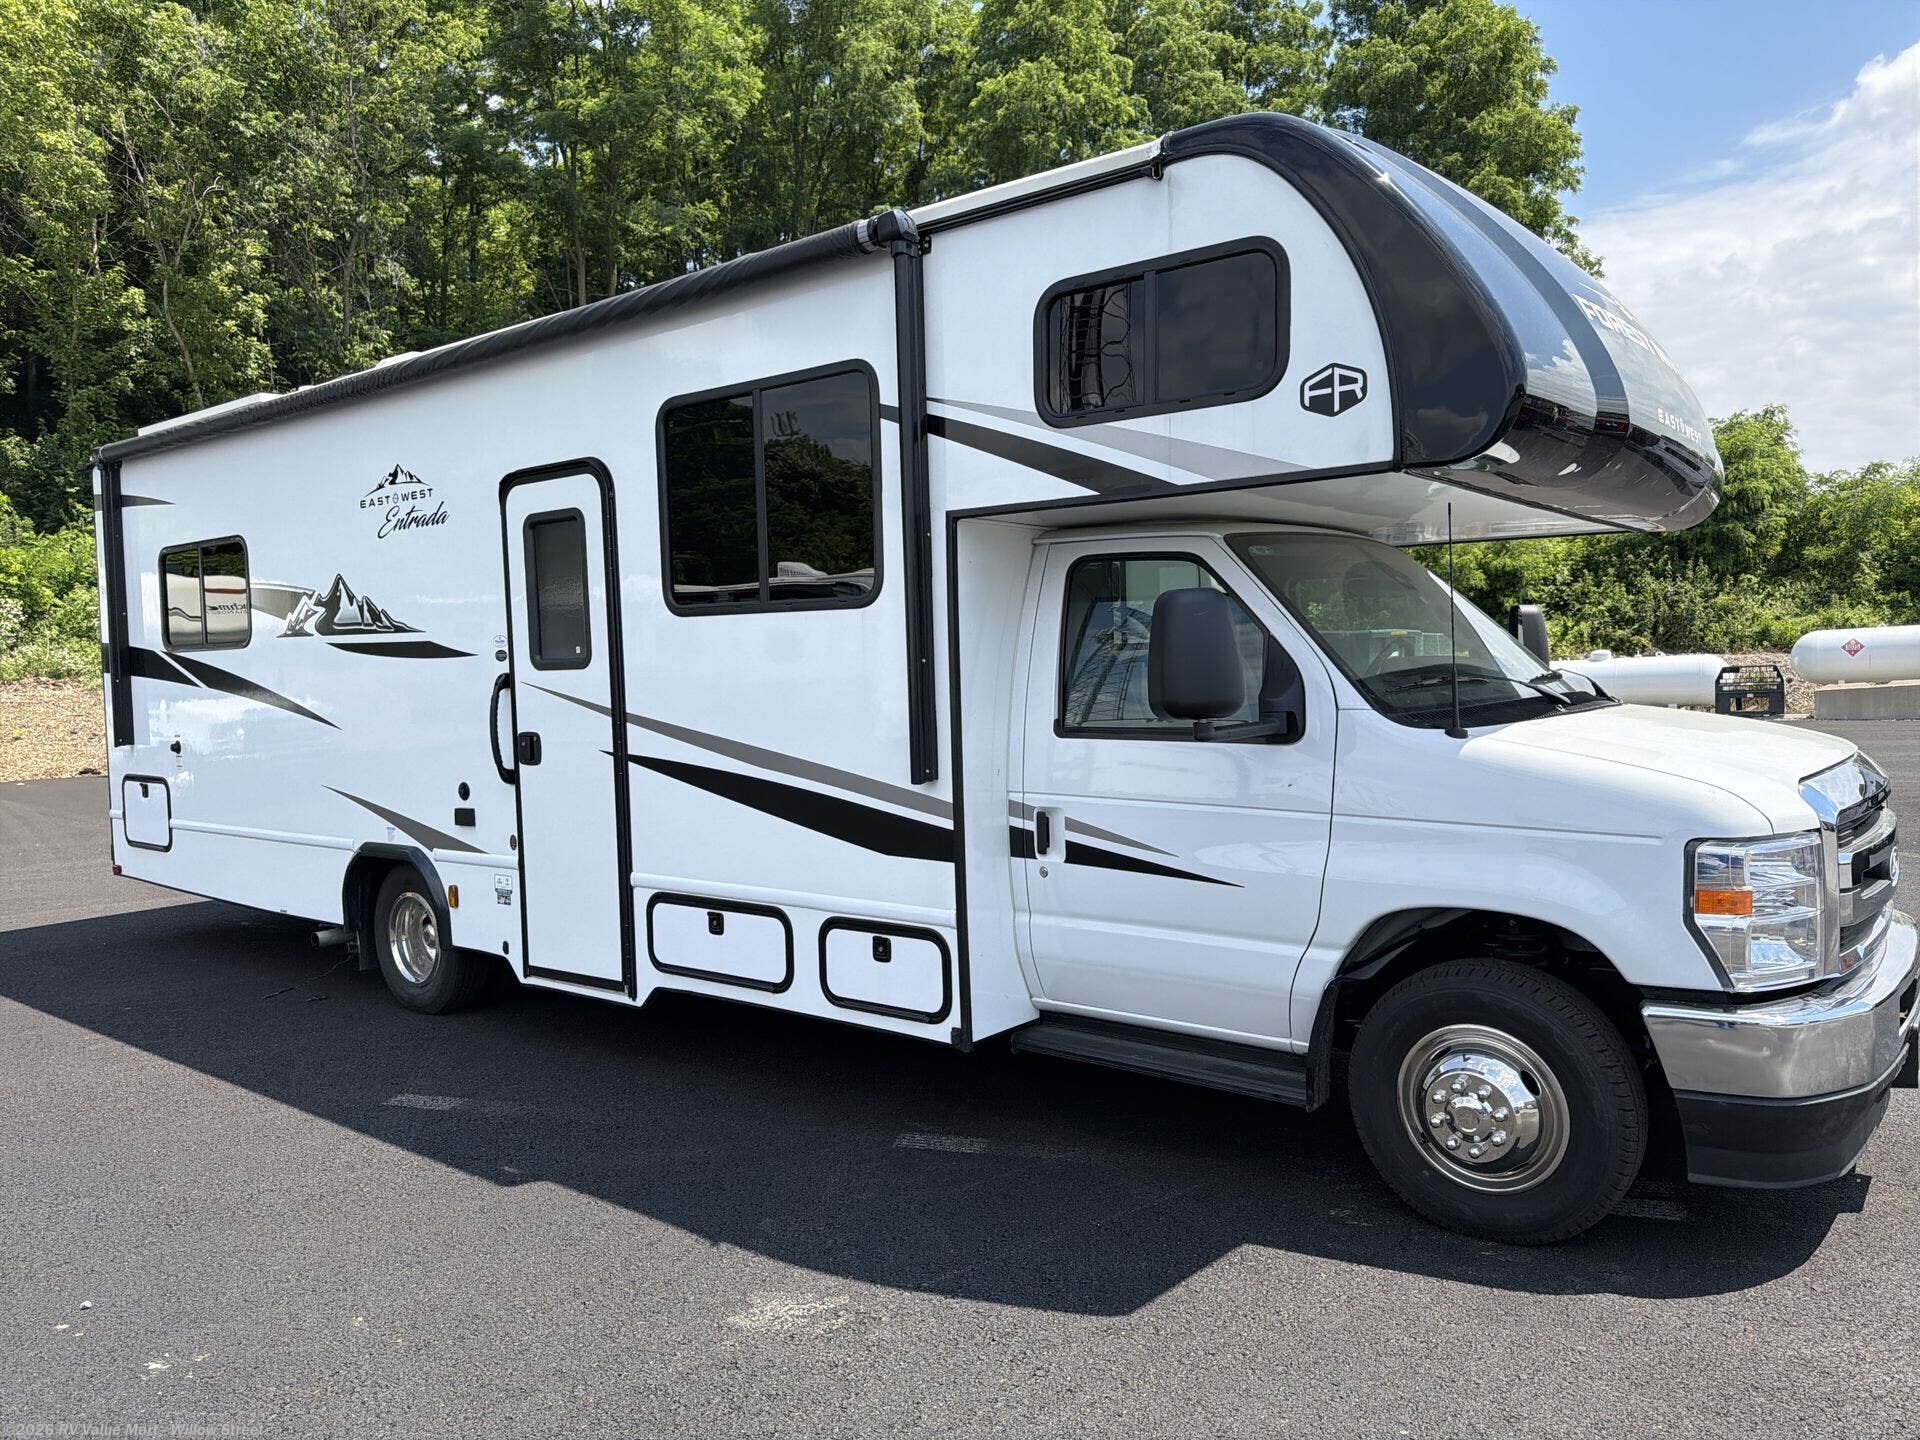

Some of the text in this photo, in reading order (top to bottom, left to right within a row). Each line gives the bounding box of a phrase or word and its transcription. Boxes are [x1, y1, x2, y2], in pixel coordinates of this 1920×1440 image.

[1657, 407, 1680, 432] EAST
[359, 487, 434, 509] EAST WEST
[377, 500, 450, 540] Entrada
